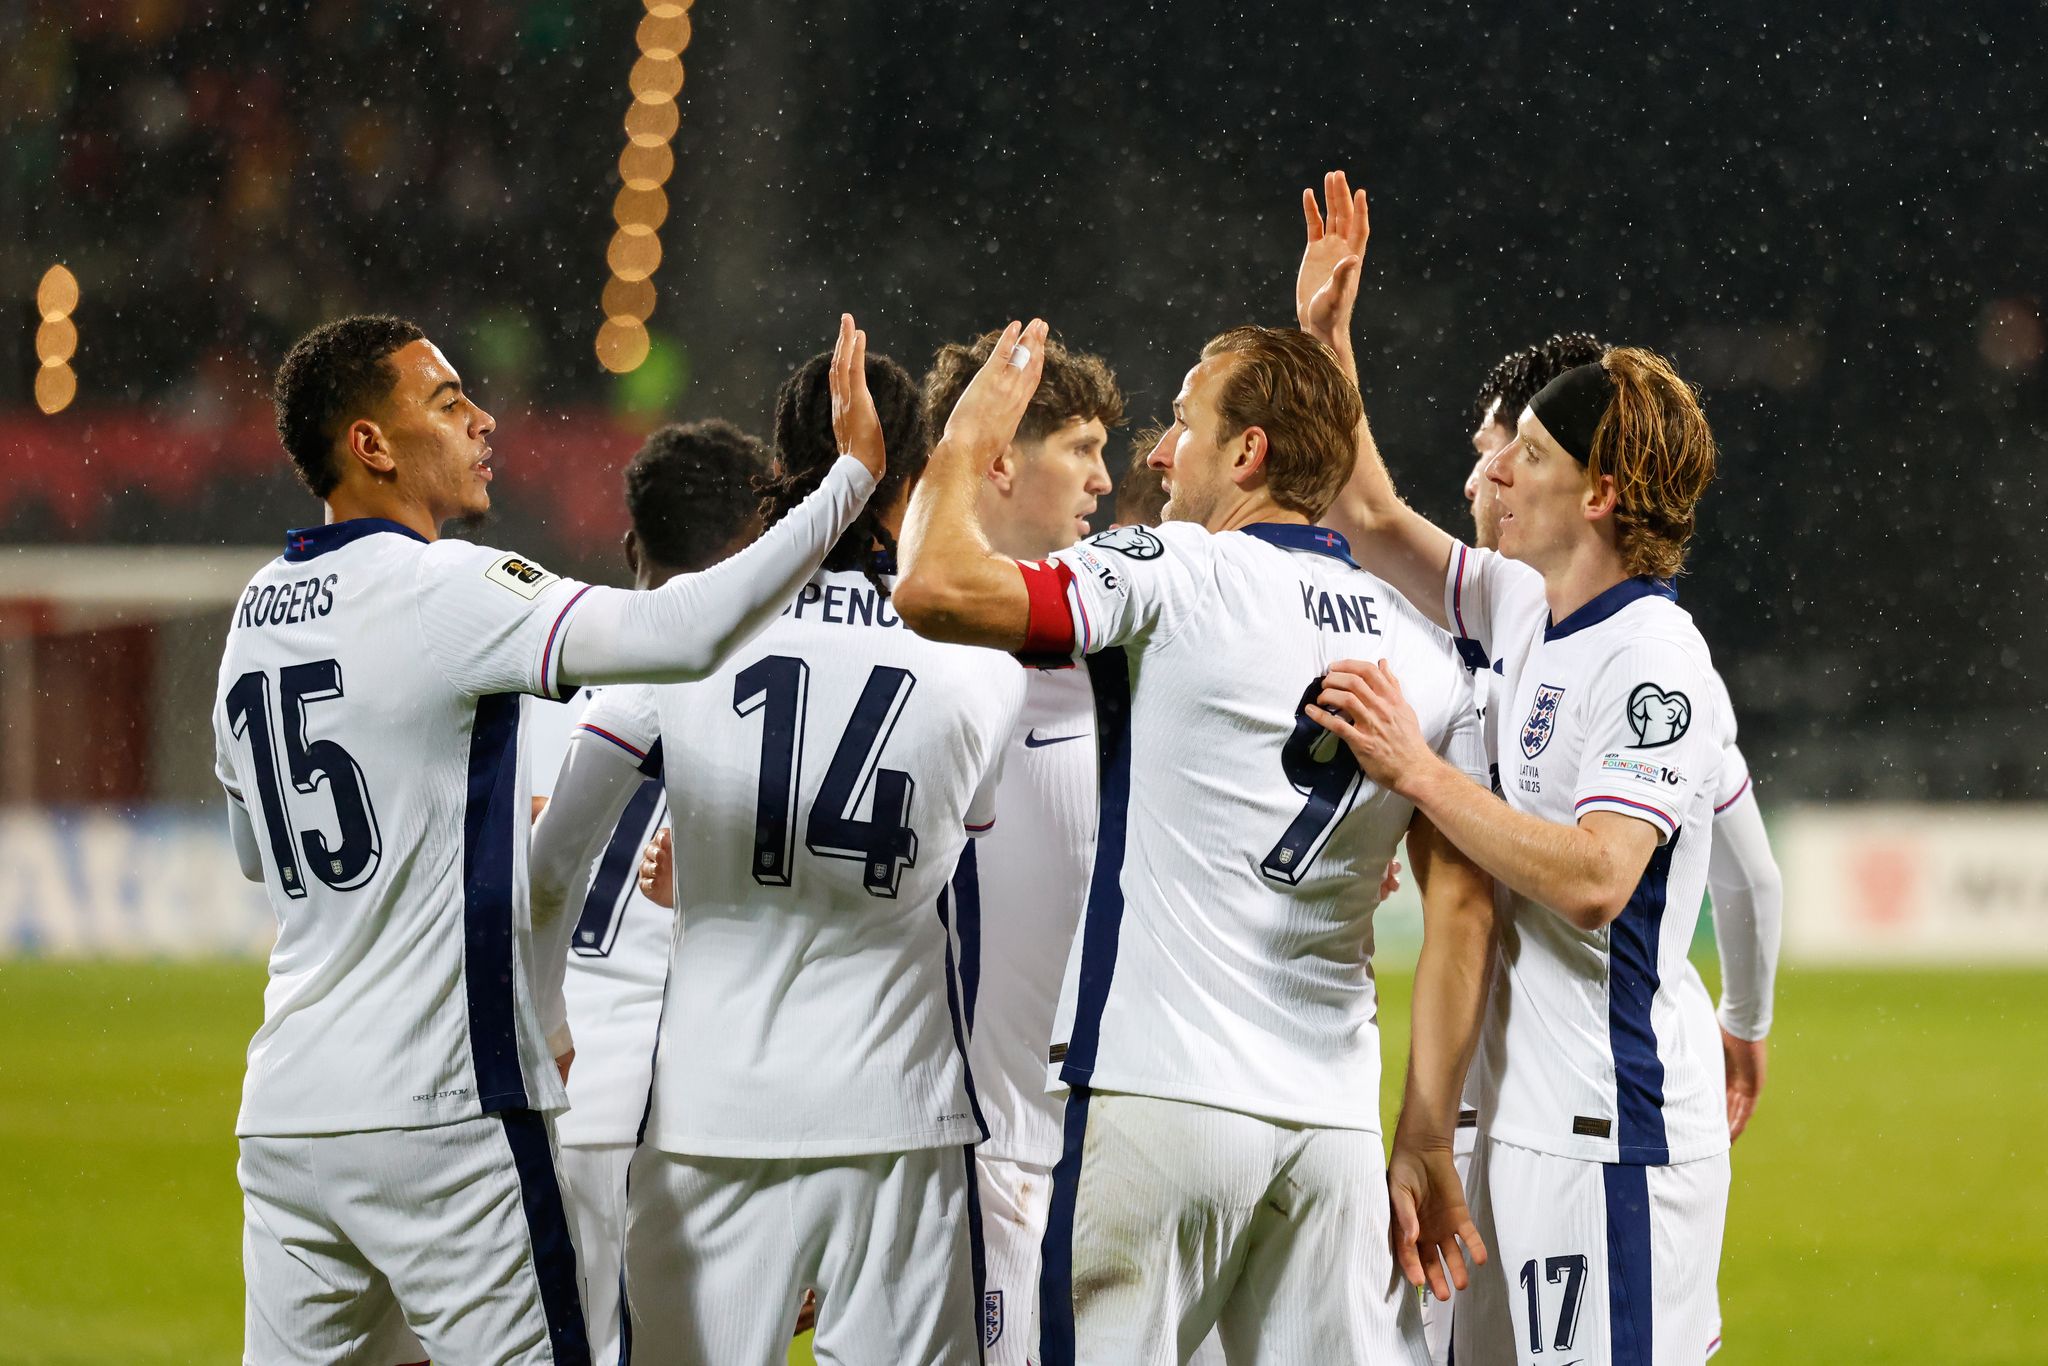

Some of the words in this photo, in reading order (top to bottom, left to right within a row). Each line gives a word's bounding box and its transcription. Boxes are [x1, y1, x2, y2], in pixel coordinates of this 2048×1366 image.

[237, 573, 338, 629] ROGERS
[781, 583, 912, 630] PENC
[1299, 580, 1382, 636] KANE
[226, 658, 382, 900] 15
[733, 655, 918, 899] 14
[1260, 676, 1366, 886] 9
[1519, 763, 1539, 779] LATVIA
[1602, 760, 1659, 776] FOUNDATION
[1520, 1254, 1588, 1354] 17
